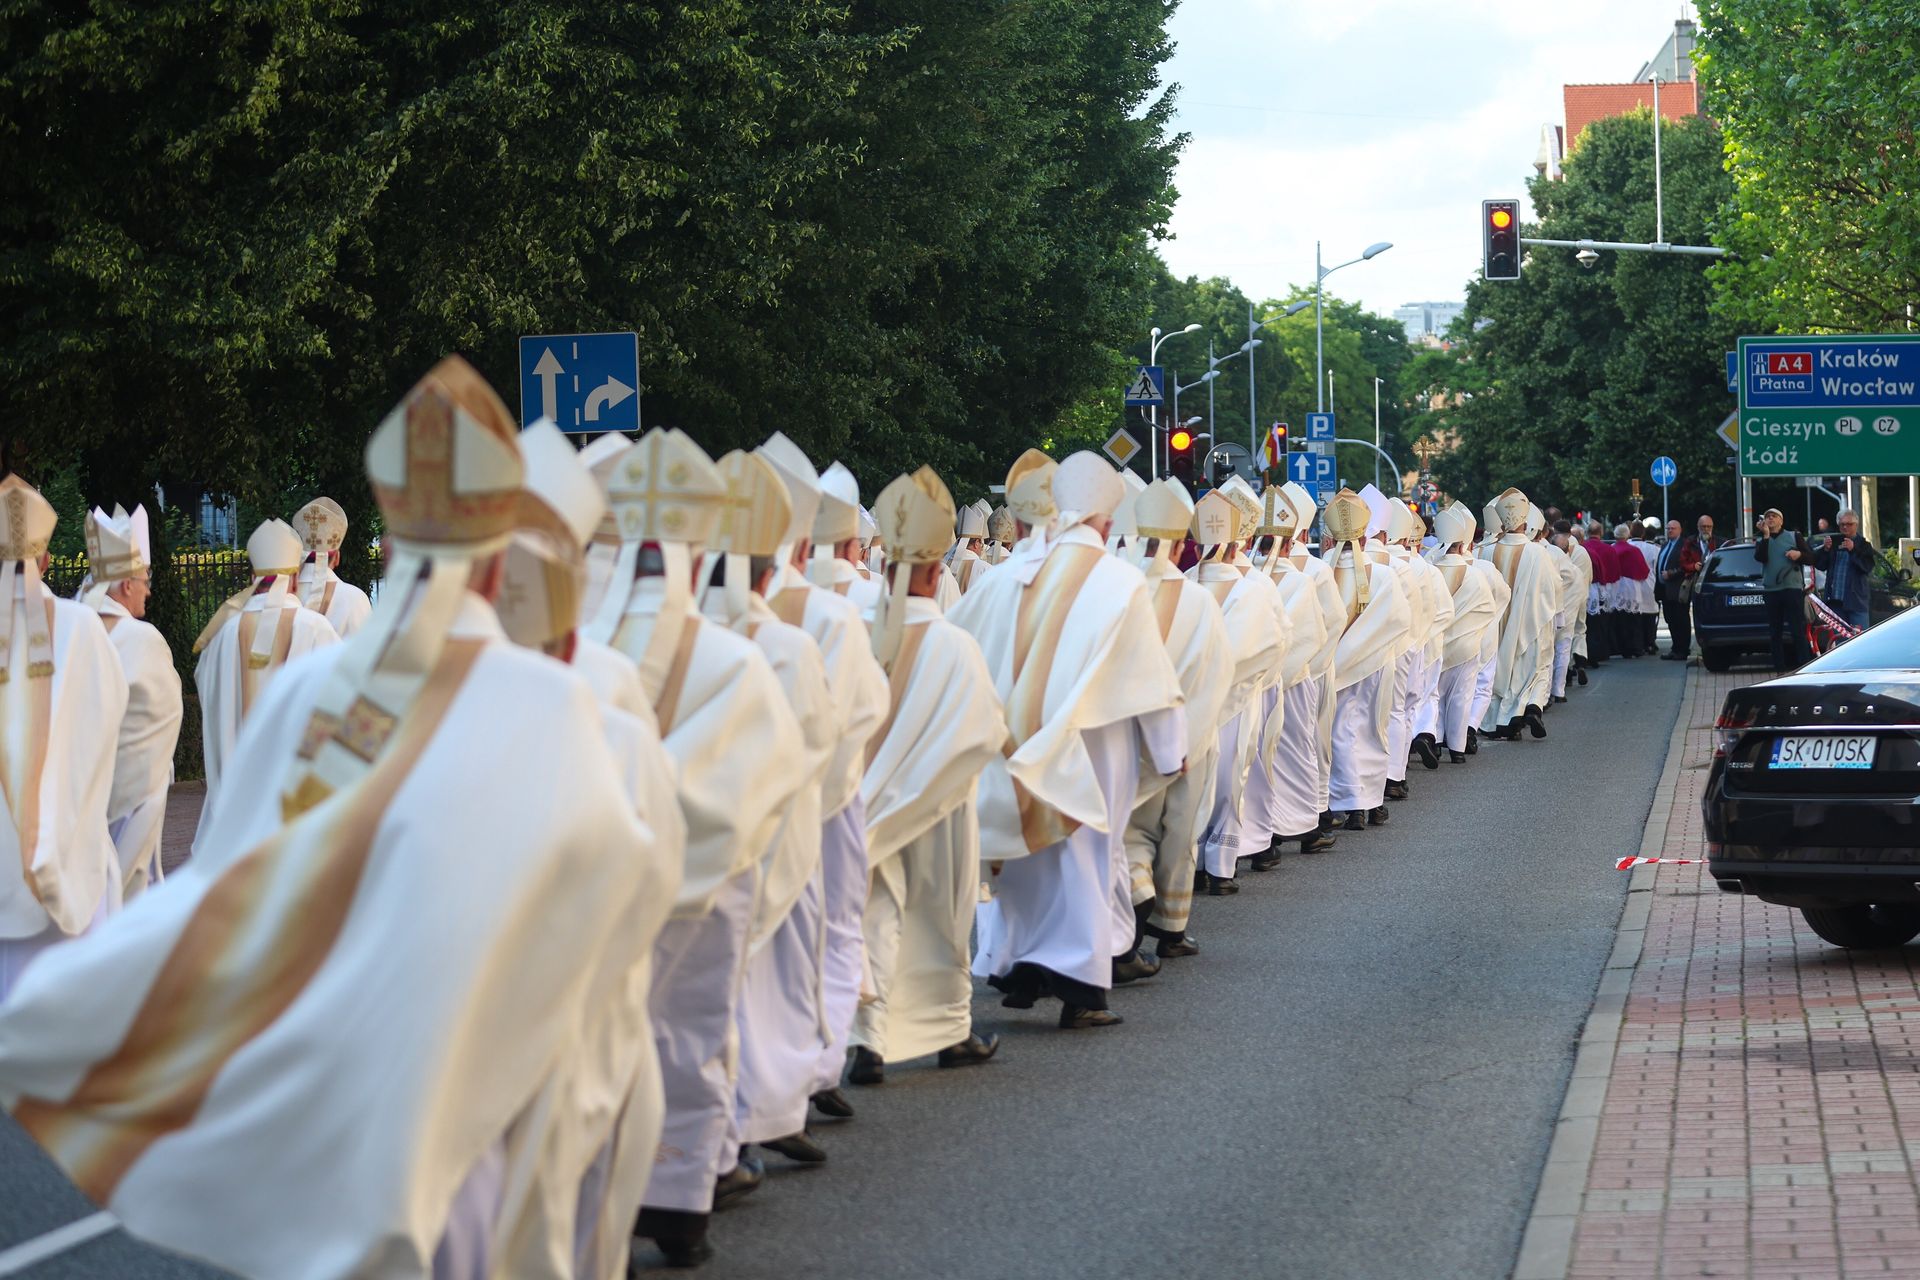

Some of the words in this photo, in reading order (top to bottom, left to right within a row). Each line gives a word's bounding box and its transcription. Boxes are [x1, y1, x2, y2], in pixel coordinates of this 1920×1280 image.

[1820, 348, 1899, 368] Kraków
[1759, 377, 1805, 390] Płatna
[1821, 377, 1915, 396] Wrocław
[1312, 415, 1329, 438] P
[1745, 417, 1826, 441] Cieszyn
[1839, 419, 1857, 433] PL
[1878, 419, 1895, 433] CZ
[1745, 445, 1799, 464] Łódź
